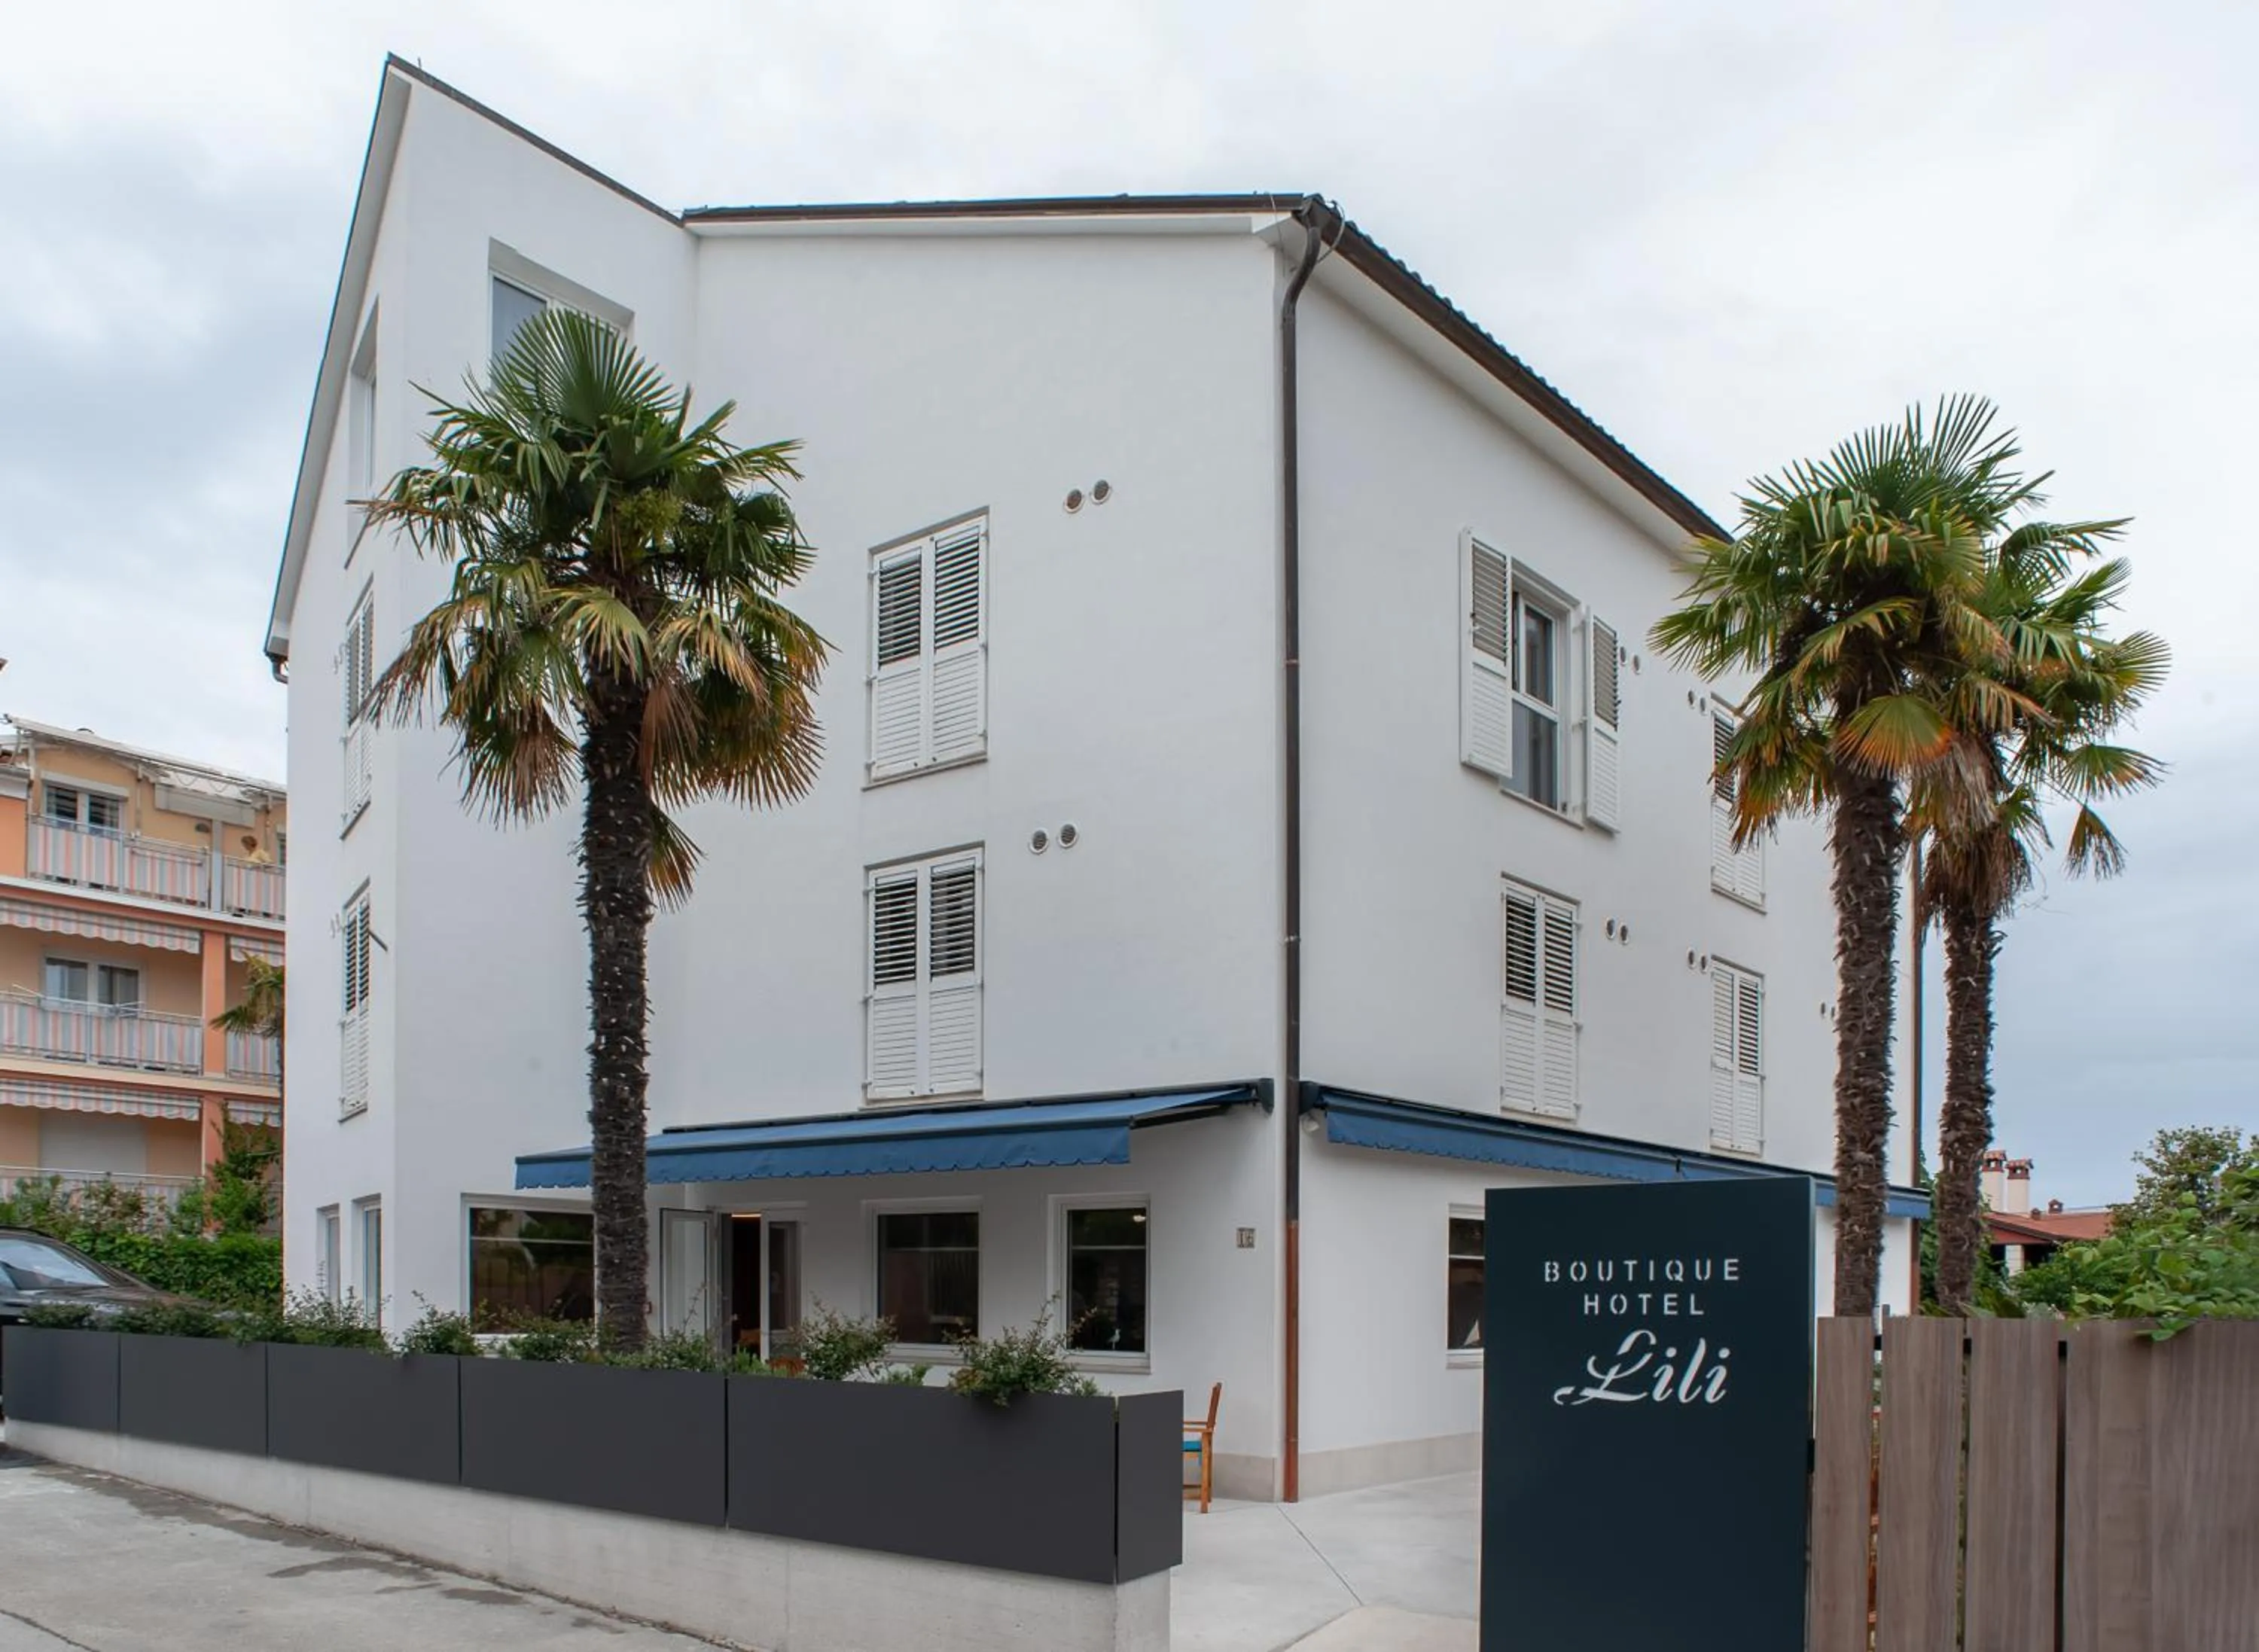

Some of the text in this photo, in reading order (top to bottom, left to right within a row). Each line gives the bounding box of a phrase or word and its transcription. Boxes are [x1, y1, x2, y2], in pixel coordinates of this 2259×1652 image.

[1544, 1258, 1740, 1282] BOUTIQUE
[1584, 1293, 1705, 1315] HOTEL
[1553, 1329, 1730, 1405] Lili
